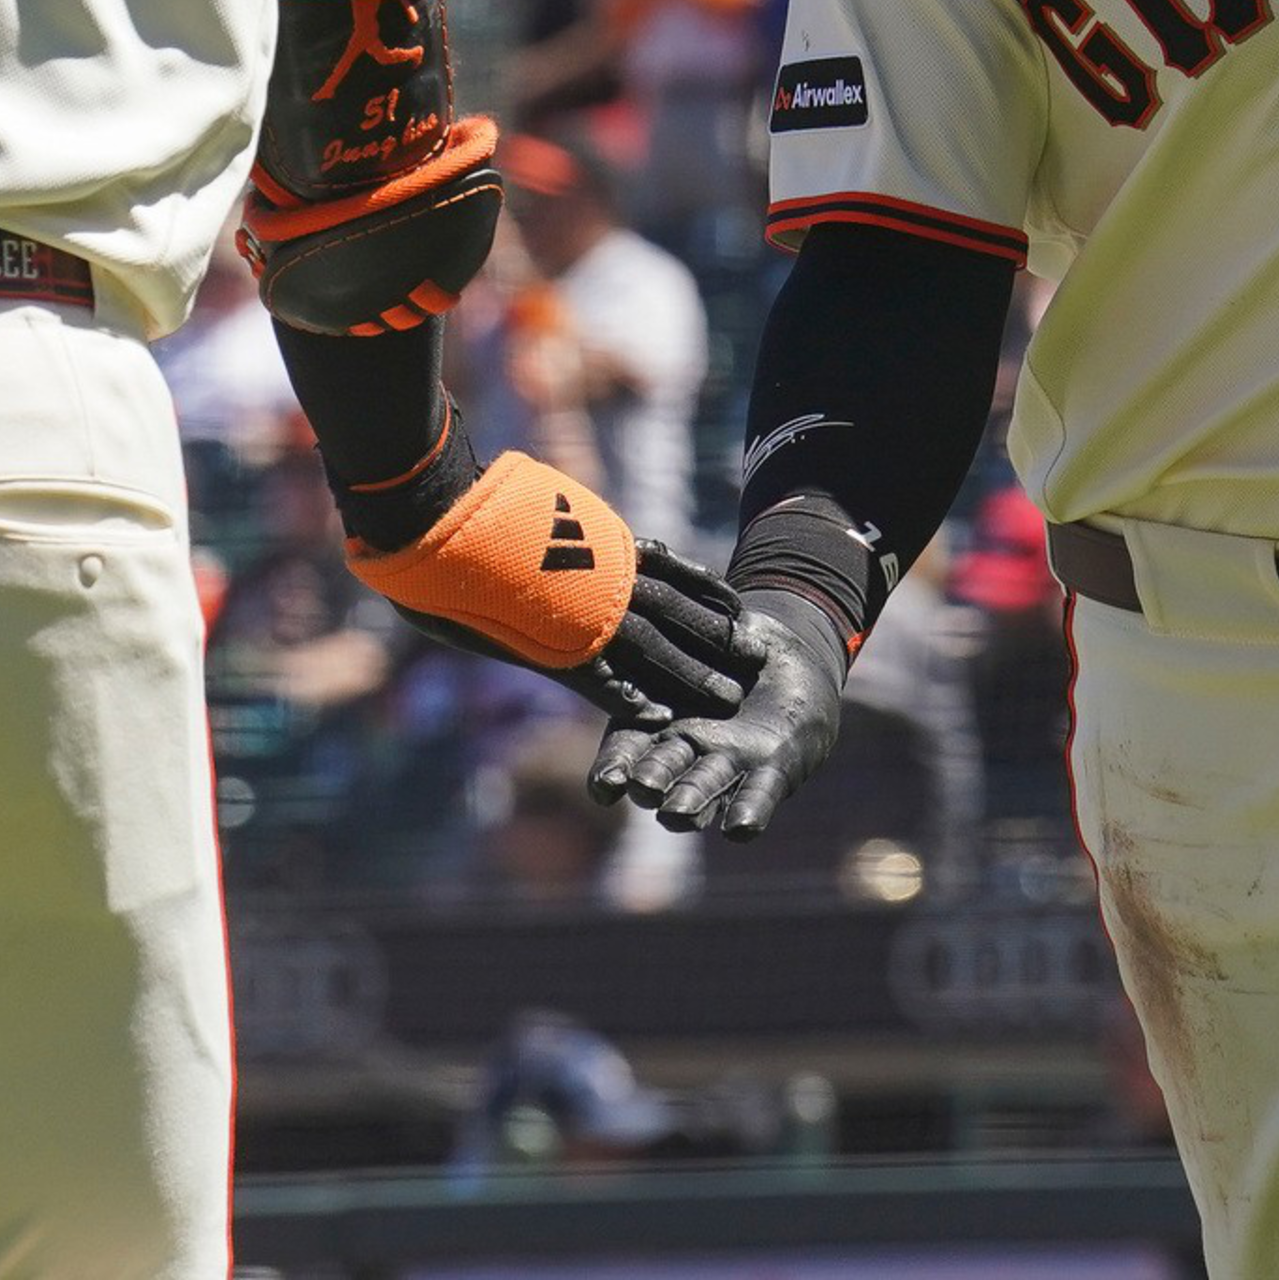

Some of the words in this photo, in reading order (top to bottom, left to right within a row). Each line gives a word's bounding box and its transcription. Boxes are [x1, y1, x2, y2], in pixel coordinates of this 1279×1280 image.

[360, 88, 399, 131] 51
[791, 79, 863, 110] Airwallex
[320, 136, 398, 172] Jung
